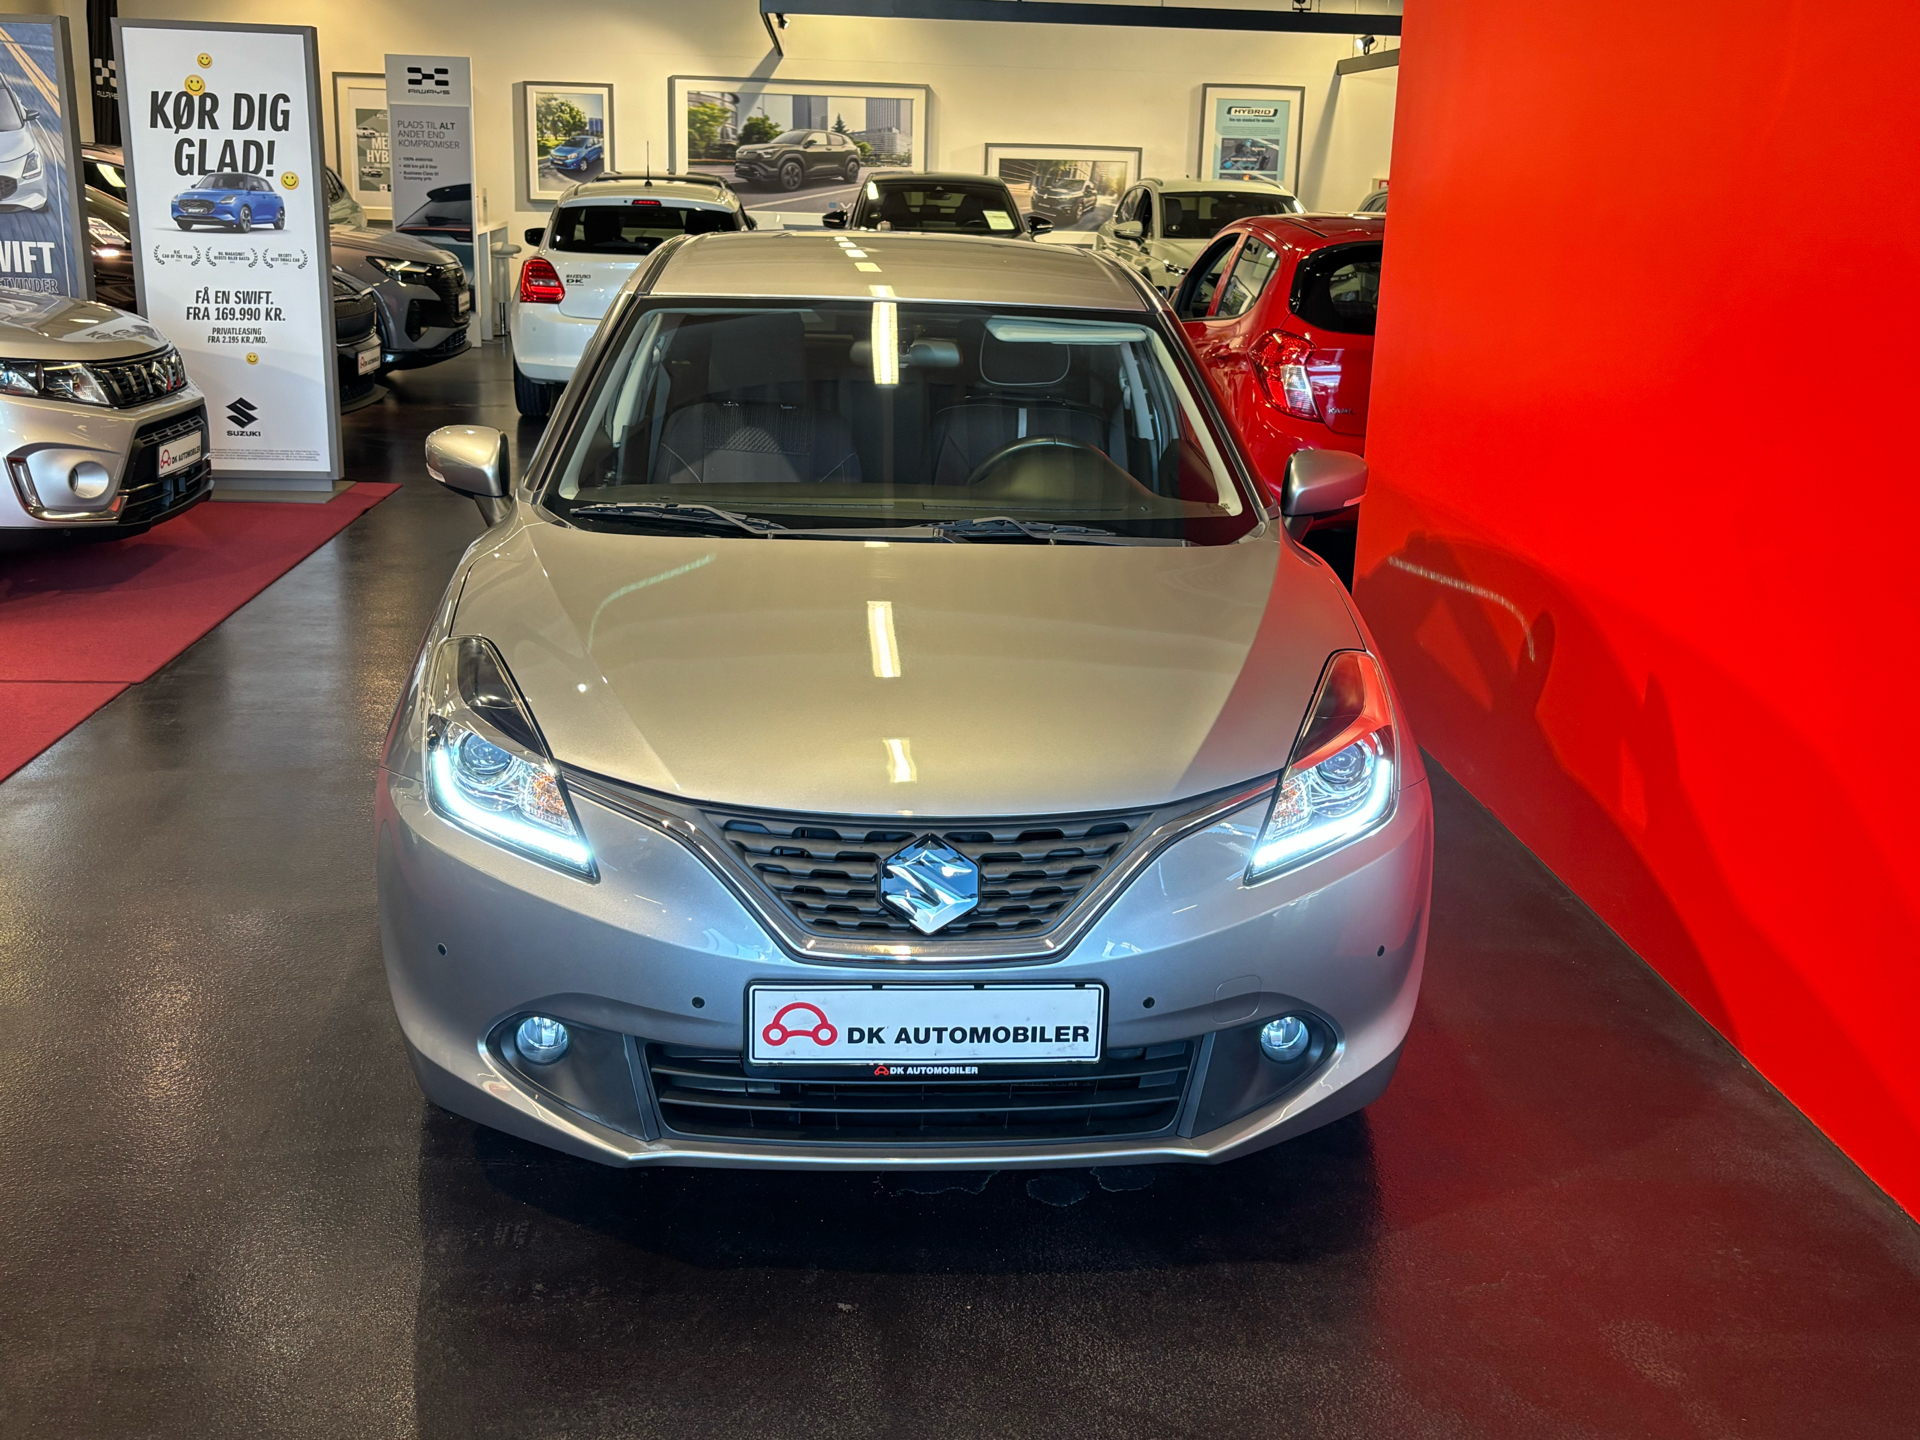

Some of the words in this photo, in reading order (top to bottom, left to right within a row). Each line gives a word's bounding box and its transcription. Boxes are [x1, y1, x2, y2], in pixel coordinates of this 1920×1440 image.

[150, 91, 220, 134] KØR
[232, 92, 291, 132] DIG
[397, 120, 424, 130] PLADS
[425, 121, 438, 130] TIL
[439, 122, 456, 131] ALT
[397, 130, 426, 138] ANDET
[427, 131, 446, 139] END
[398, 139, 460, 149] KOMPROMISER
[174, 137, 276, 177] GLAD!
[195, 286, 210, 305] FÅ
[214, 290, 231, 305] EN
[234, 290, 274, 305] SWIFT.
[186, 306, 211, 321] FRA
[214, 307, 261, 321] 169.990
[265, 307, 286, 322] KR.
[212, 327, 262, 336] PRIVATLEASING
[207, 335, 221, 344] FRA
[222, 336, 240, 344] 2.195
[240, 336, 268, 345] KR./MD.
[847, 1027, 887, 1045] DK
[894, 1025, 1090, 1045] AUTOMOBILER
[889, 1066, 905, 1075] DK
[906, 1066, 979, 1075] AUTOMOBILER
